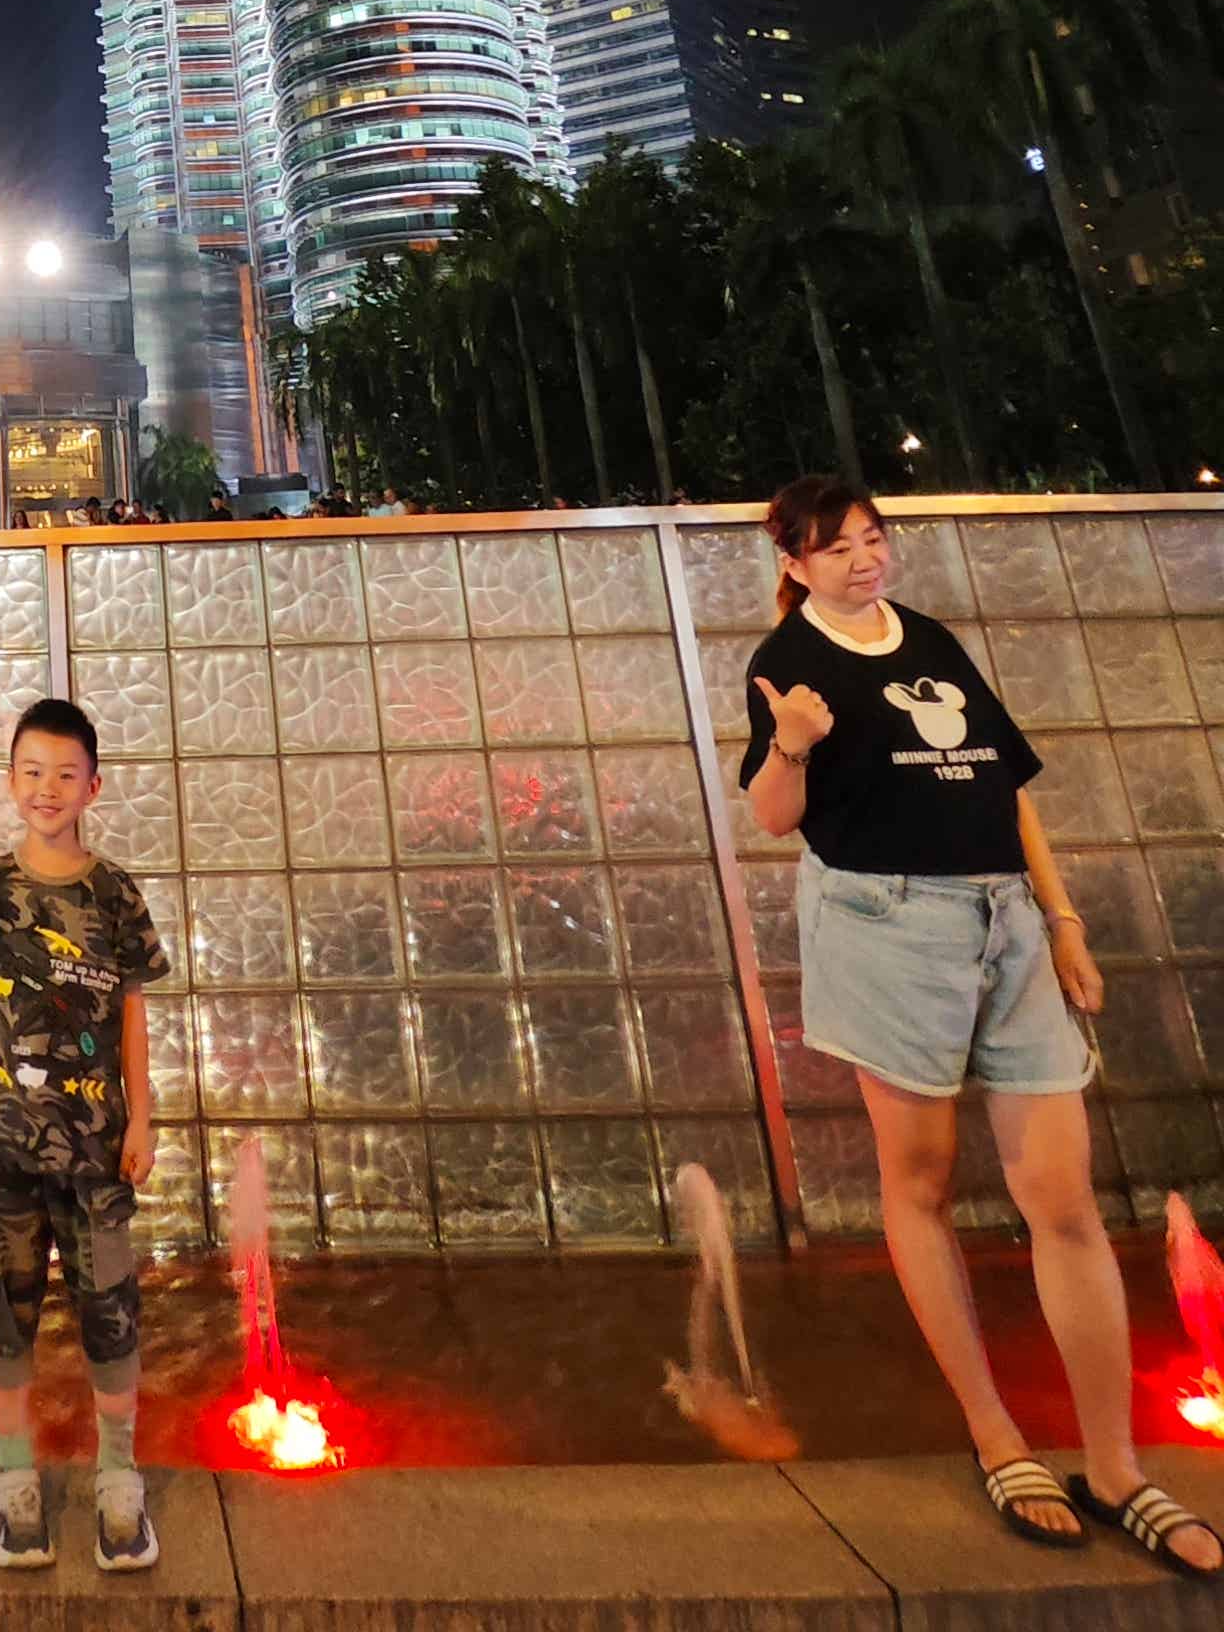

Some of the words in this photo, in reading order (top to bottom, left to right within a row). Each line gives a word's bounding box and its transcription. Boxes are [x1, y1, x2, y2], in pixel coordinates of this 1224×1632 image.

[945, 747, 999, 763] MOUSE
[933, 765, 975, 781] 1928
[49, 958, 73, 972] TOM
